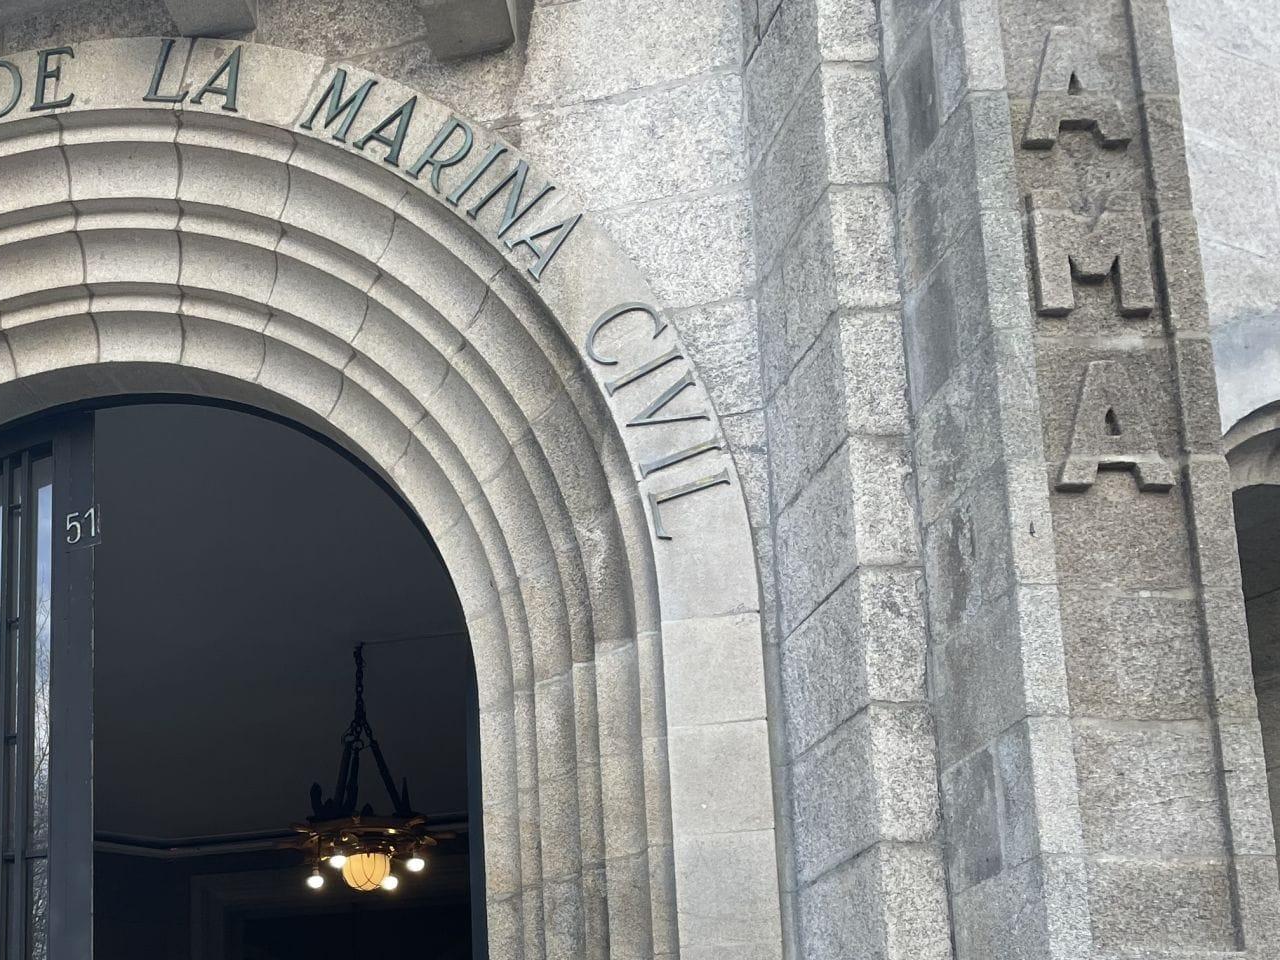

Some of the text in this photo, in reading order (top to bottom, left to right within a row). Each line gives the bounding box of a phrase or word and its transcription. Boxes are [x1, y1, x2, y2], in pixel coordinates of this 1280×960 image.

[142, 38, 242, 113] LA
[300, 68, 584, 282] MARINA
[585, 301, 732, 541] CIVIL
[1021, 26, 1176, 493] AMA
[66, 507, 96, 544] 51
